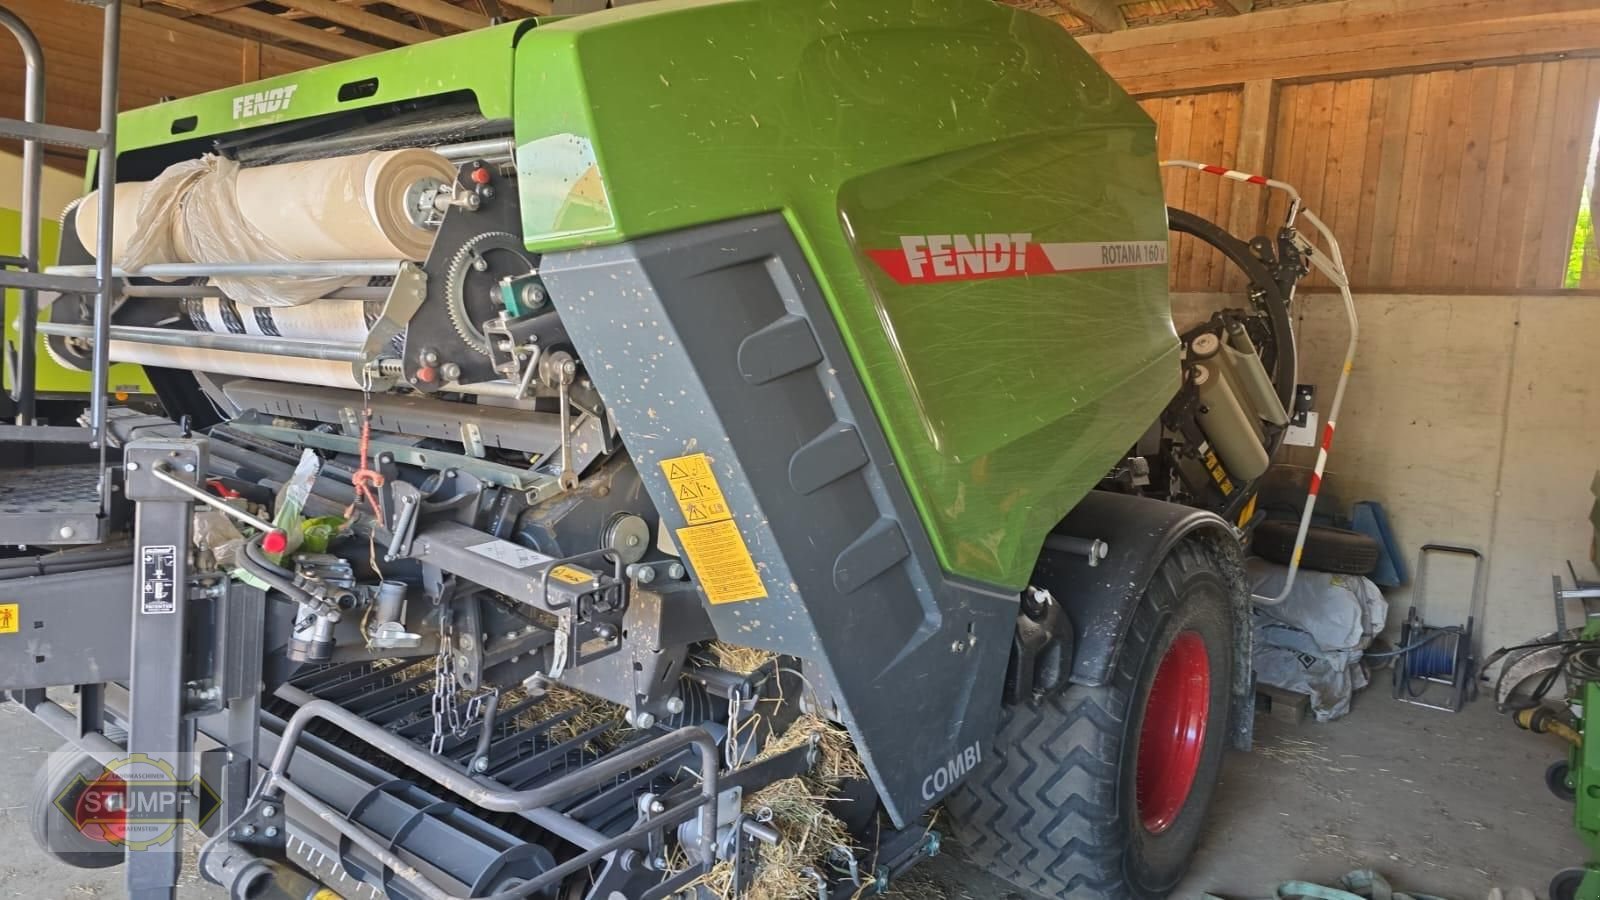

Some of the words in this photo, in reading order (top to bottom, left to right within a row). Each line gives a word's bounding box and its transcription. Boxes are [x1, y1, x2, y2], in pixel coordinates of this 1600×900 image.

[233, 84, 298, 119] FENDT
[900, 233, 1032, 278] FENDT
[1101, 244, 1142, 265] ROTANA
[1143, 244, 1160, 262] 160
[922, 740, 982, 801] COMBI
